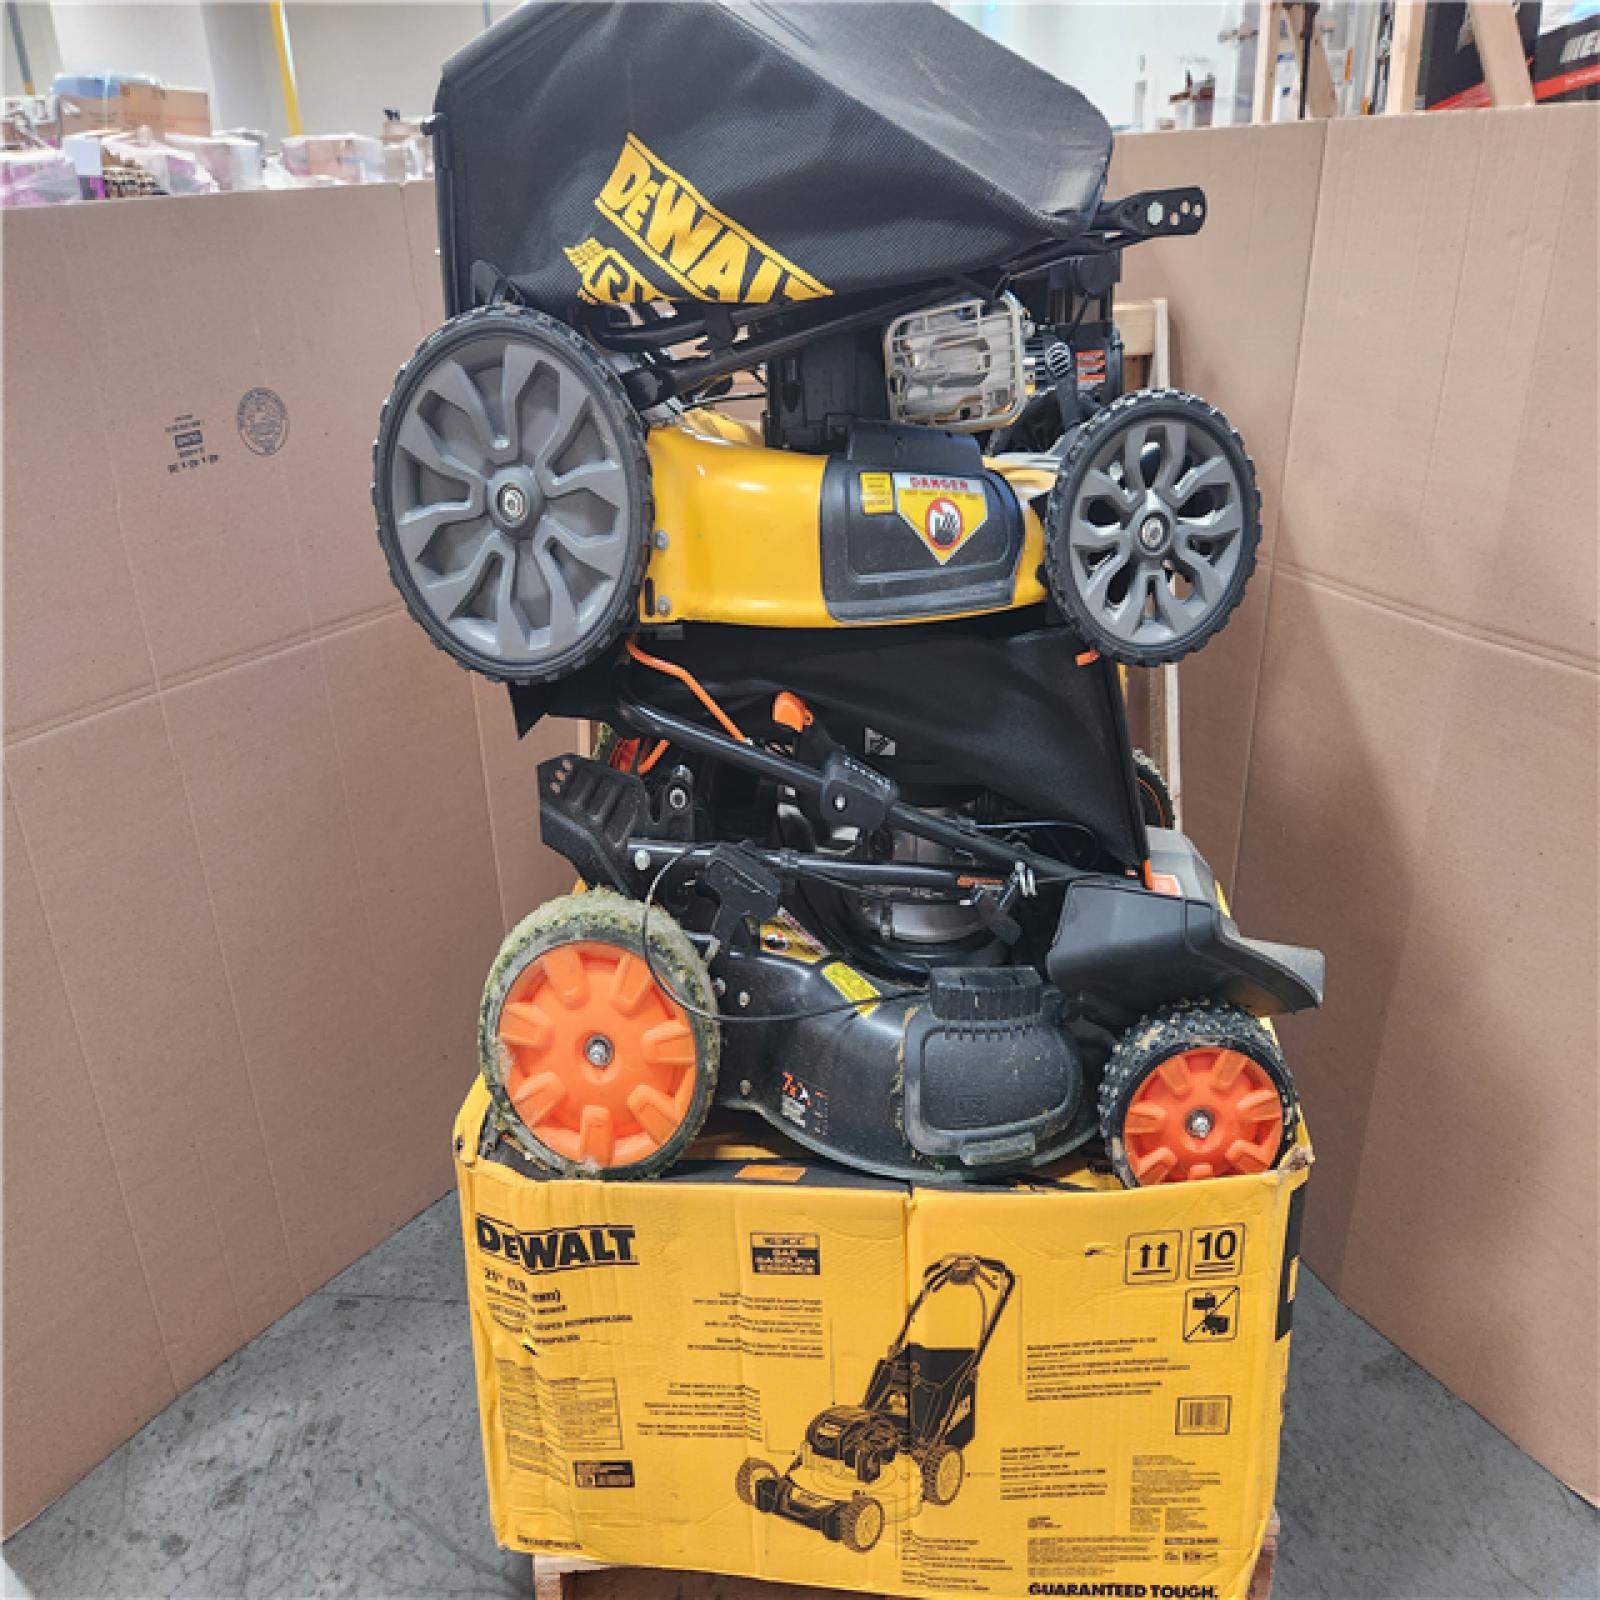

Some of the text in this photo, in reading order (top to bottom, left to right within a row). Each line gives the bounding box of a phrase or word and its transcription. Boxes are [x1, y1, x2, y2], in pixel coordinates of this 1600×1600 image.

[909, 476, 969, 490] DANGER
[476, 1217, 636, 1270] DEWALT
[1197, 1230, 1237, 1261] 10
[1028, 1583, 1219, 1599] GUARANTEED TOUGH.
